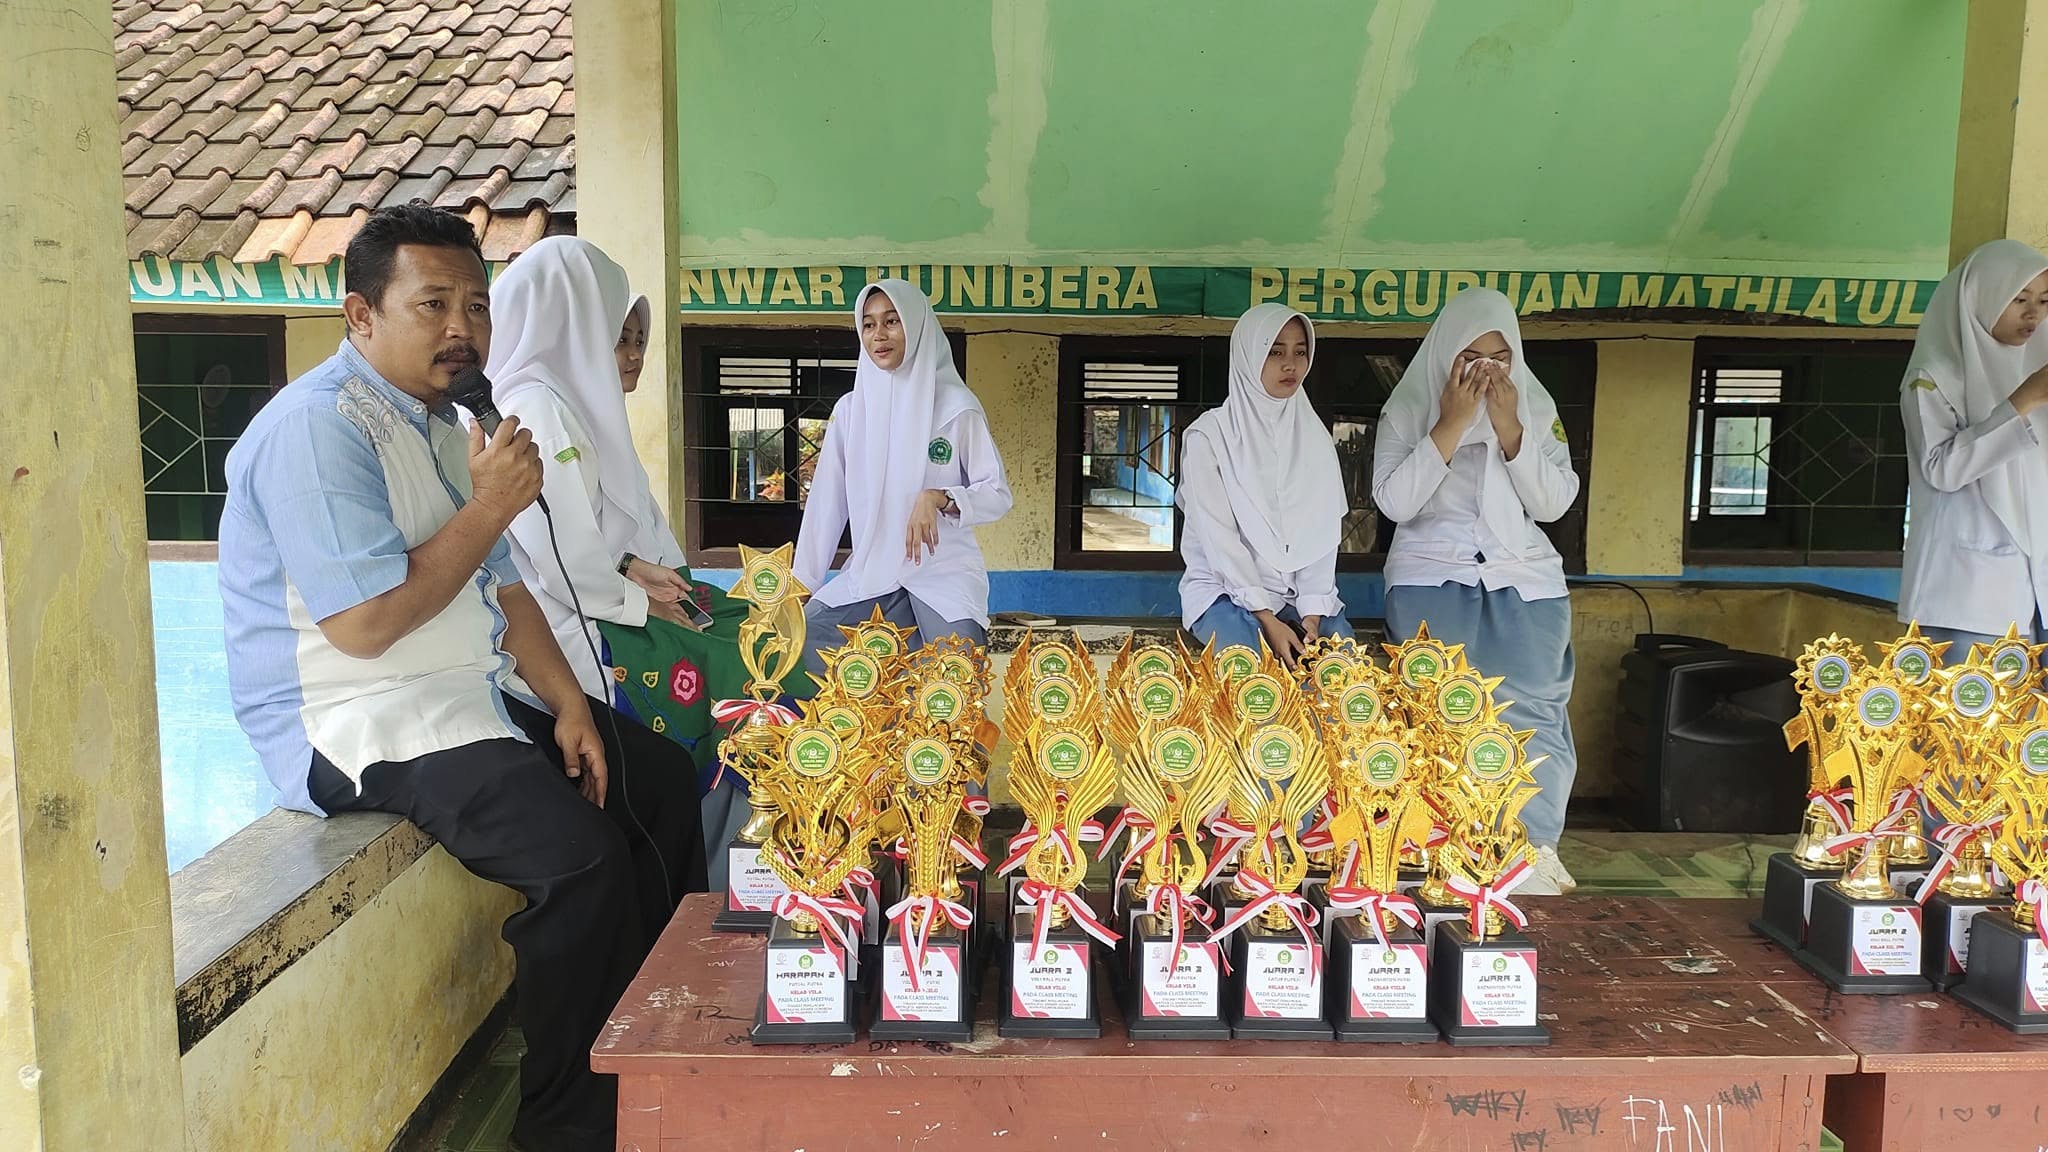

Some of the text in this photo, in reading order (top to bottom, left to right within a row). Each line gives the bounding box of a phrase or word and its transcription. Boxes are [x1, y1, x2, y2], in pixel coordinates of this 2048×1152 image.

[130, 252, 346, 299] UAN M
[1617, 274, 1925, 326] MATHLA'UL
[776, 971, 825, 979] HARAPAN
